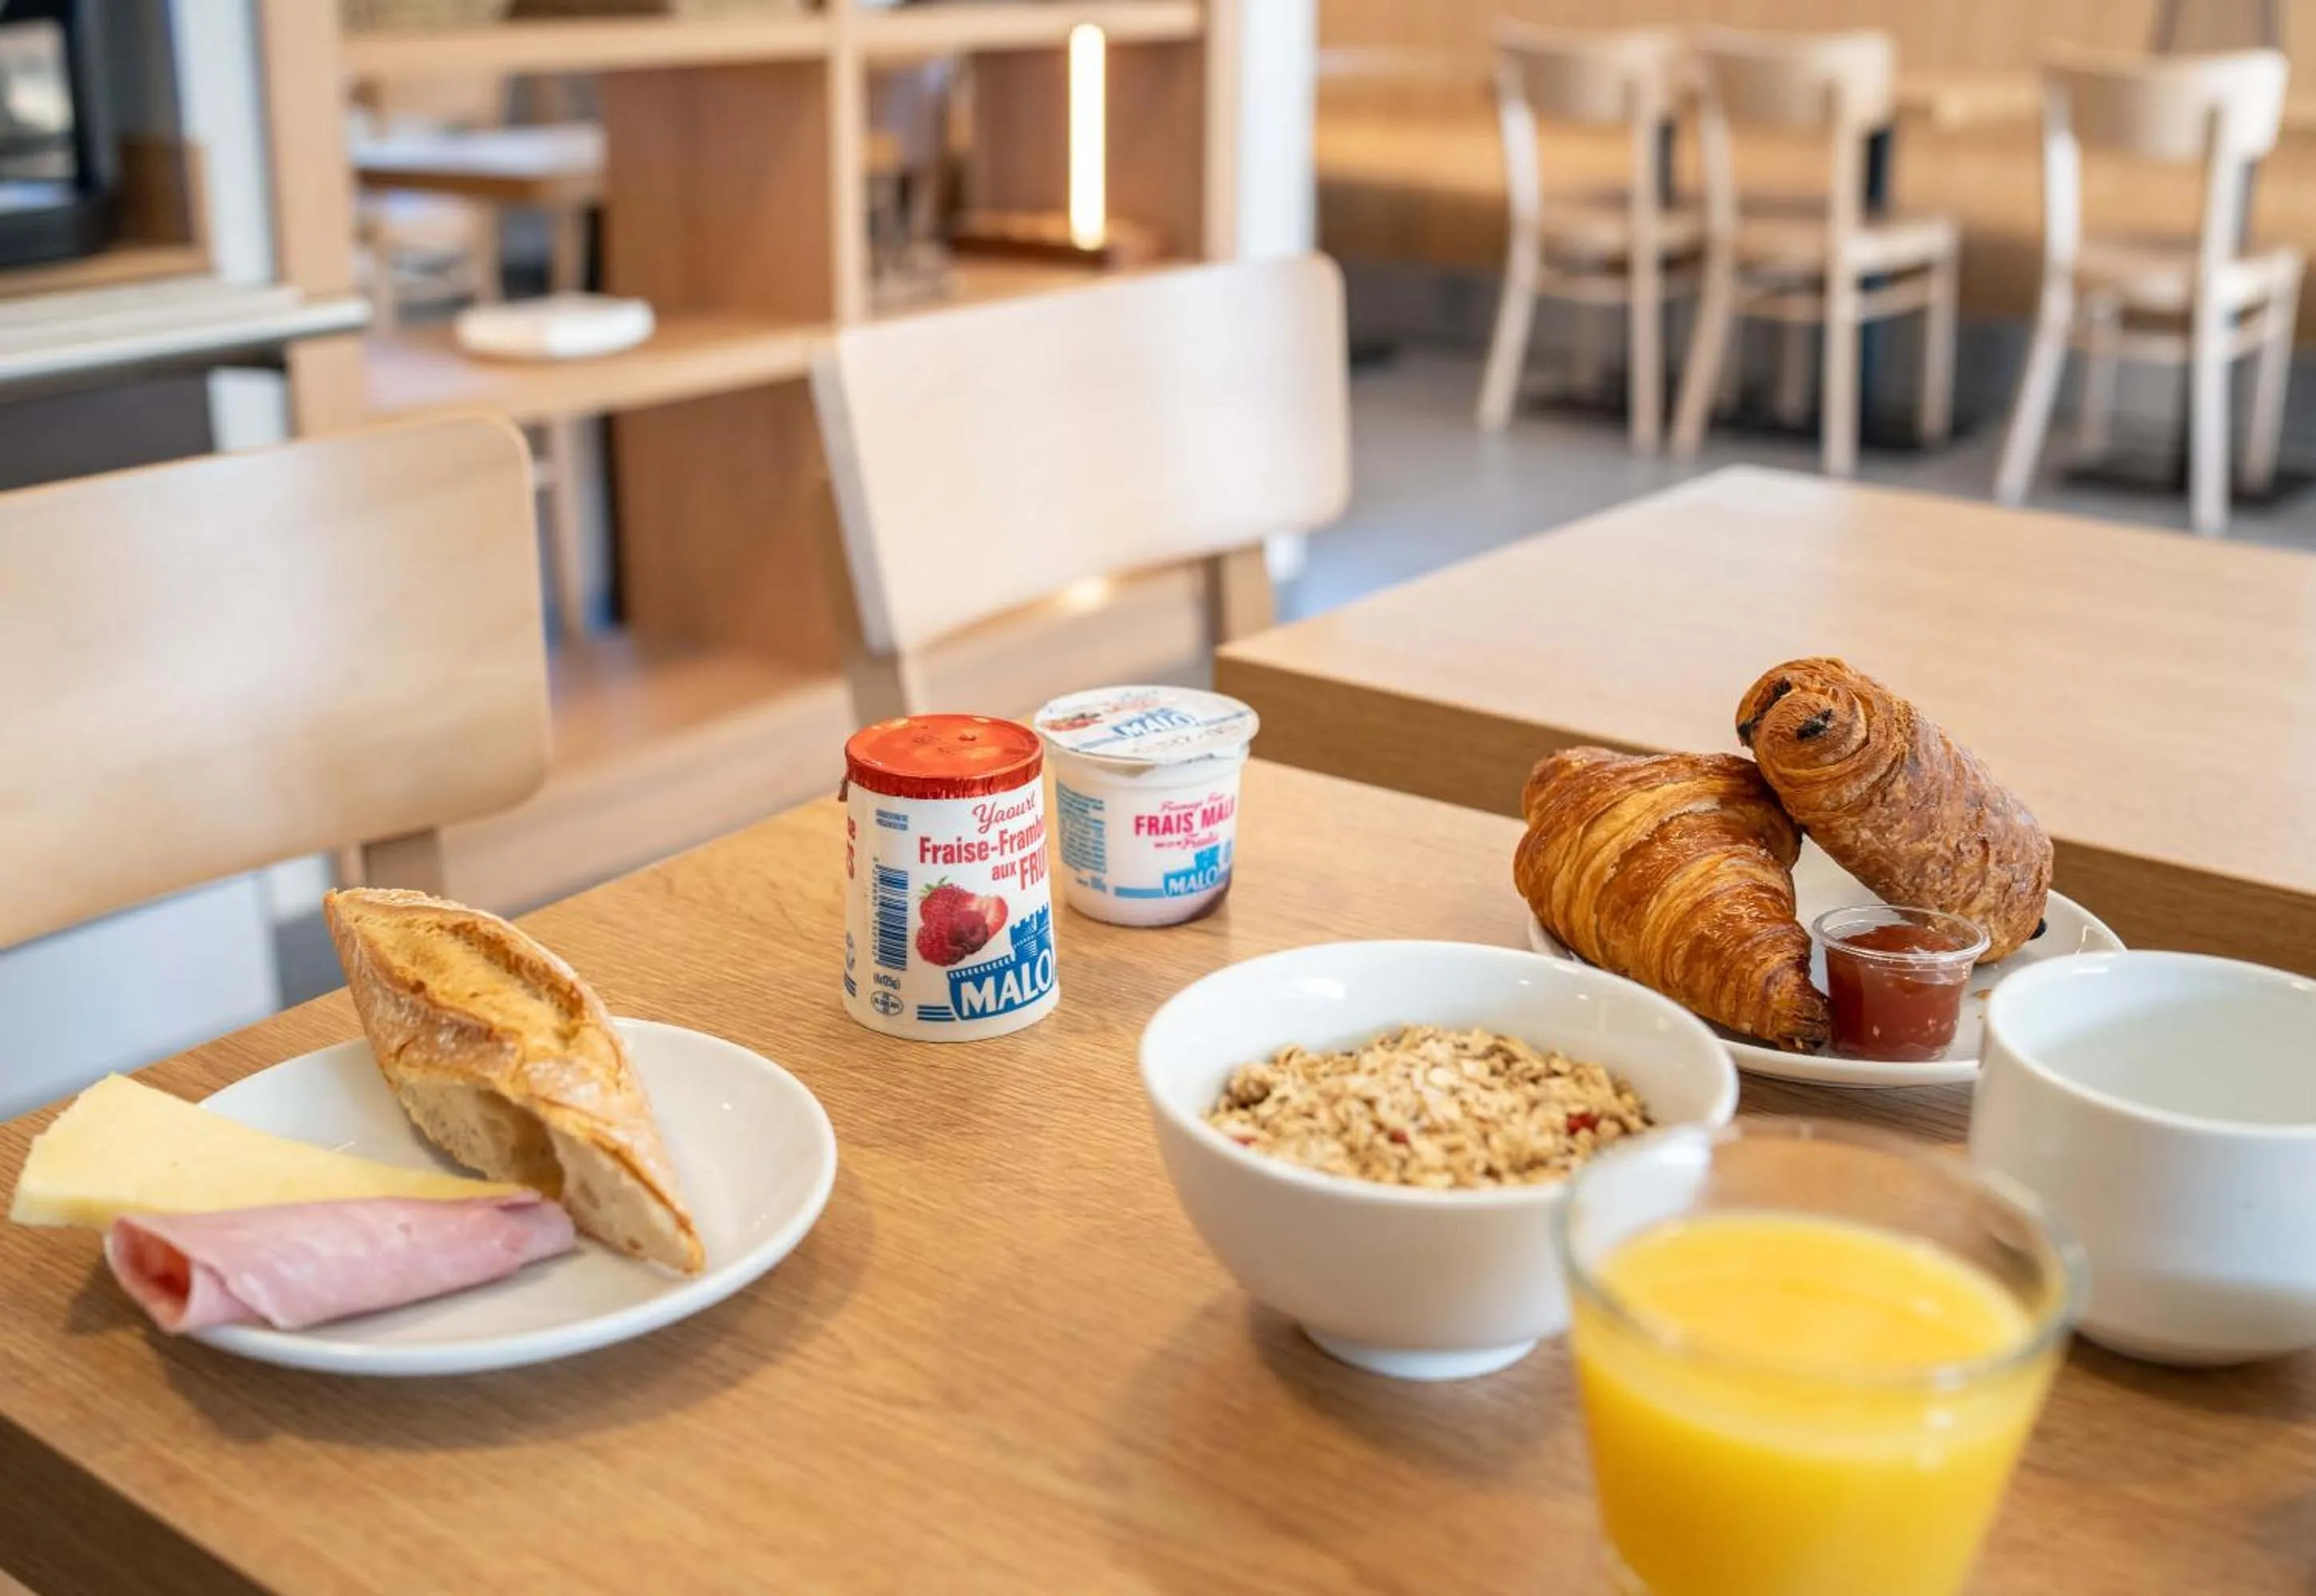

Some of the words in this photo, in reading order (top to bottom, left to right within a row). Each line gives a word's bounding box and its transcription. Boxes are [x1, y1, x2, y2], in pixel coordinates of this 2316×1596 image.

[972, 790, 1037, 834] Yaourt
[1135, 811, 1194, 836] FRAIS
[991, 861, 1017, 881] aux
[1019, 842, 1048, 891] FRU
[1168, 865, 1219, 896] MALO
[961, 948, 1053, 1016] MALO
